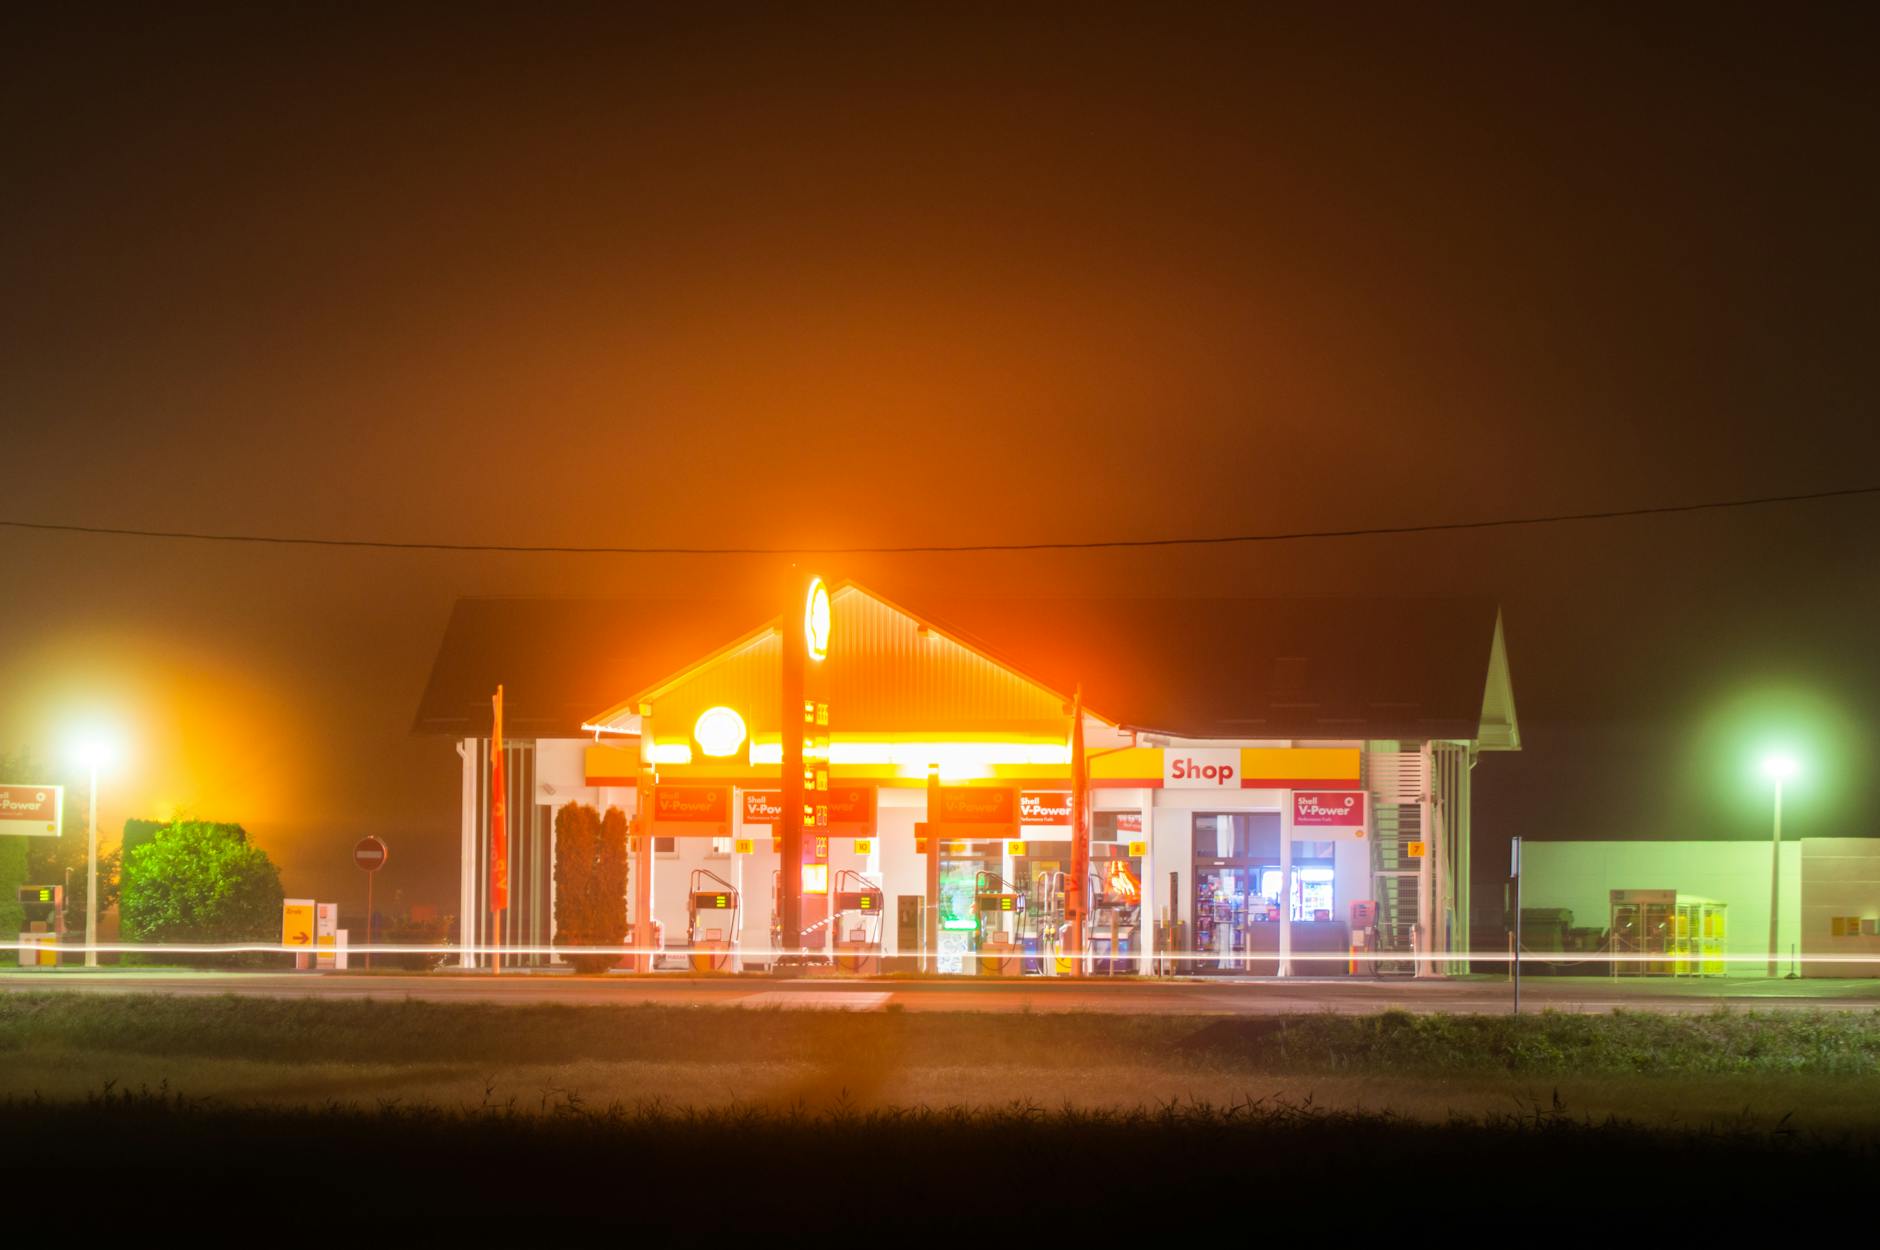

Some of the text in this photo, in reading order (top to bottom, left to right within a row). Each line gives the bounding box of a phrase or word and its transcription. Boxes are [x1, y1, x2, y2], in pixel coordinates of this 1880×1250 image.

[1172, 758, 1234, 785] Shop
[0, 799, 41, 810] -Power
[747, 796, 766, 804] Shell
[1020, 797, 1040, 805] Shell
[1298, 796, 1318, 805] Shell
[659, 800, 713, 812] V-Power
[747, 804, 782, 814] V-Pow
[945, 800, 999, 812] V-Power
[1020, 805, 1072, 816] V-Power
[1298, 805, 1351, 816] V-Power
